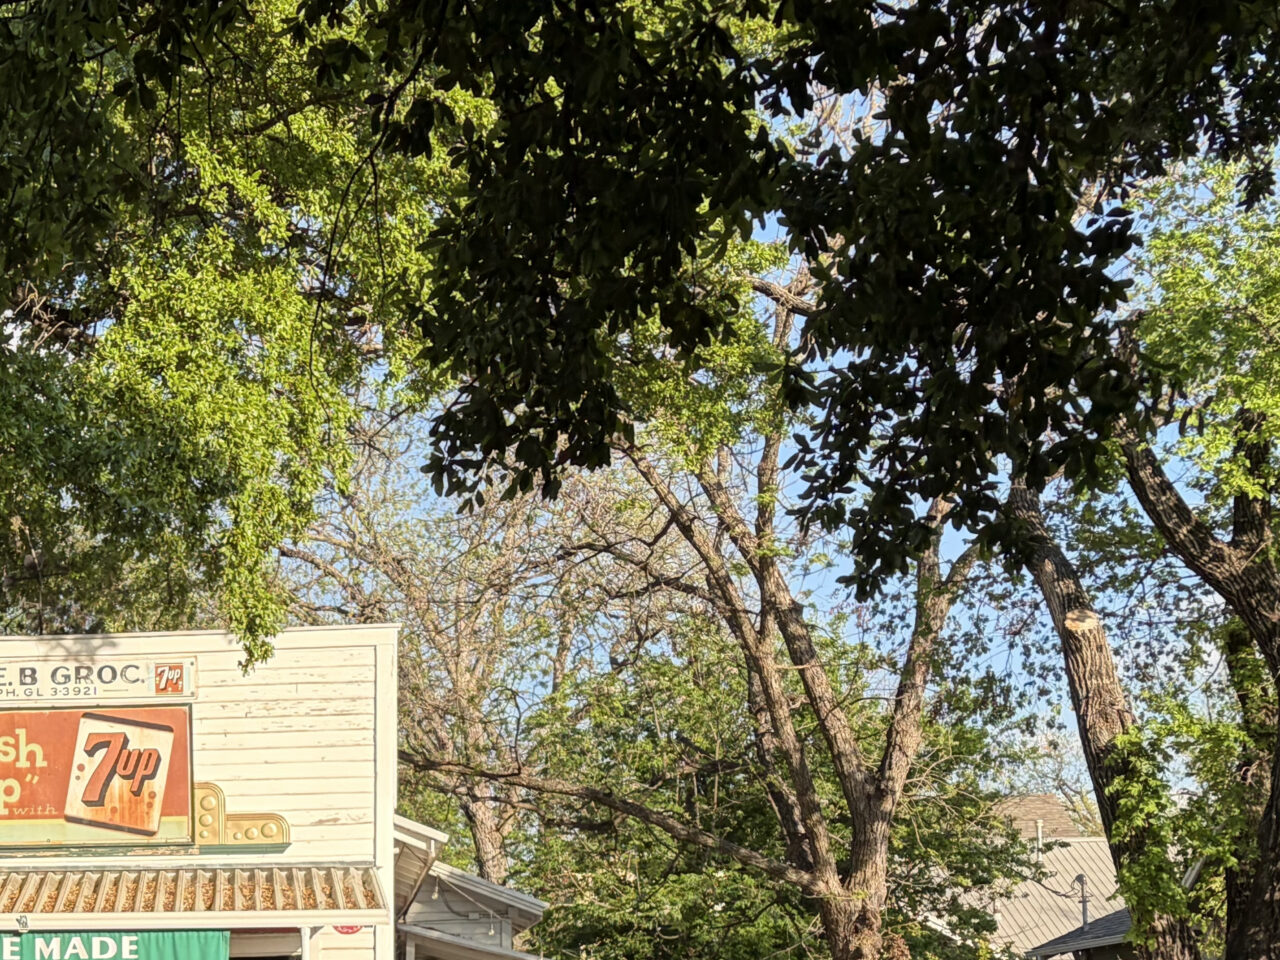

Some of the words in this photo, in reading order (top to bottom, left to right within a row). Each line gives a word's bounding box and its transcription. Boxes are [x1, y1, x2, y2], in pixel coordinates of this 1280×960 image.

[19, 667, 38, 686] B
[50, 664, 145, 685] GROC.
[24, 688, 44, 697] GL
[12, 804, 58, 816] with
[34, 935, 139, 960] MADE
